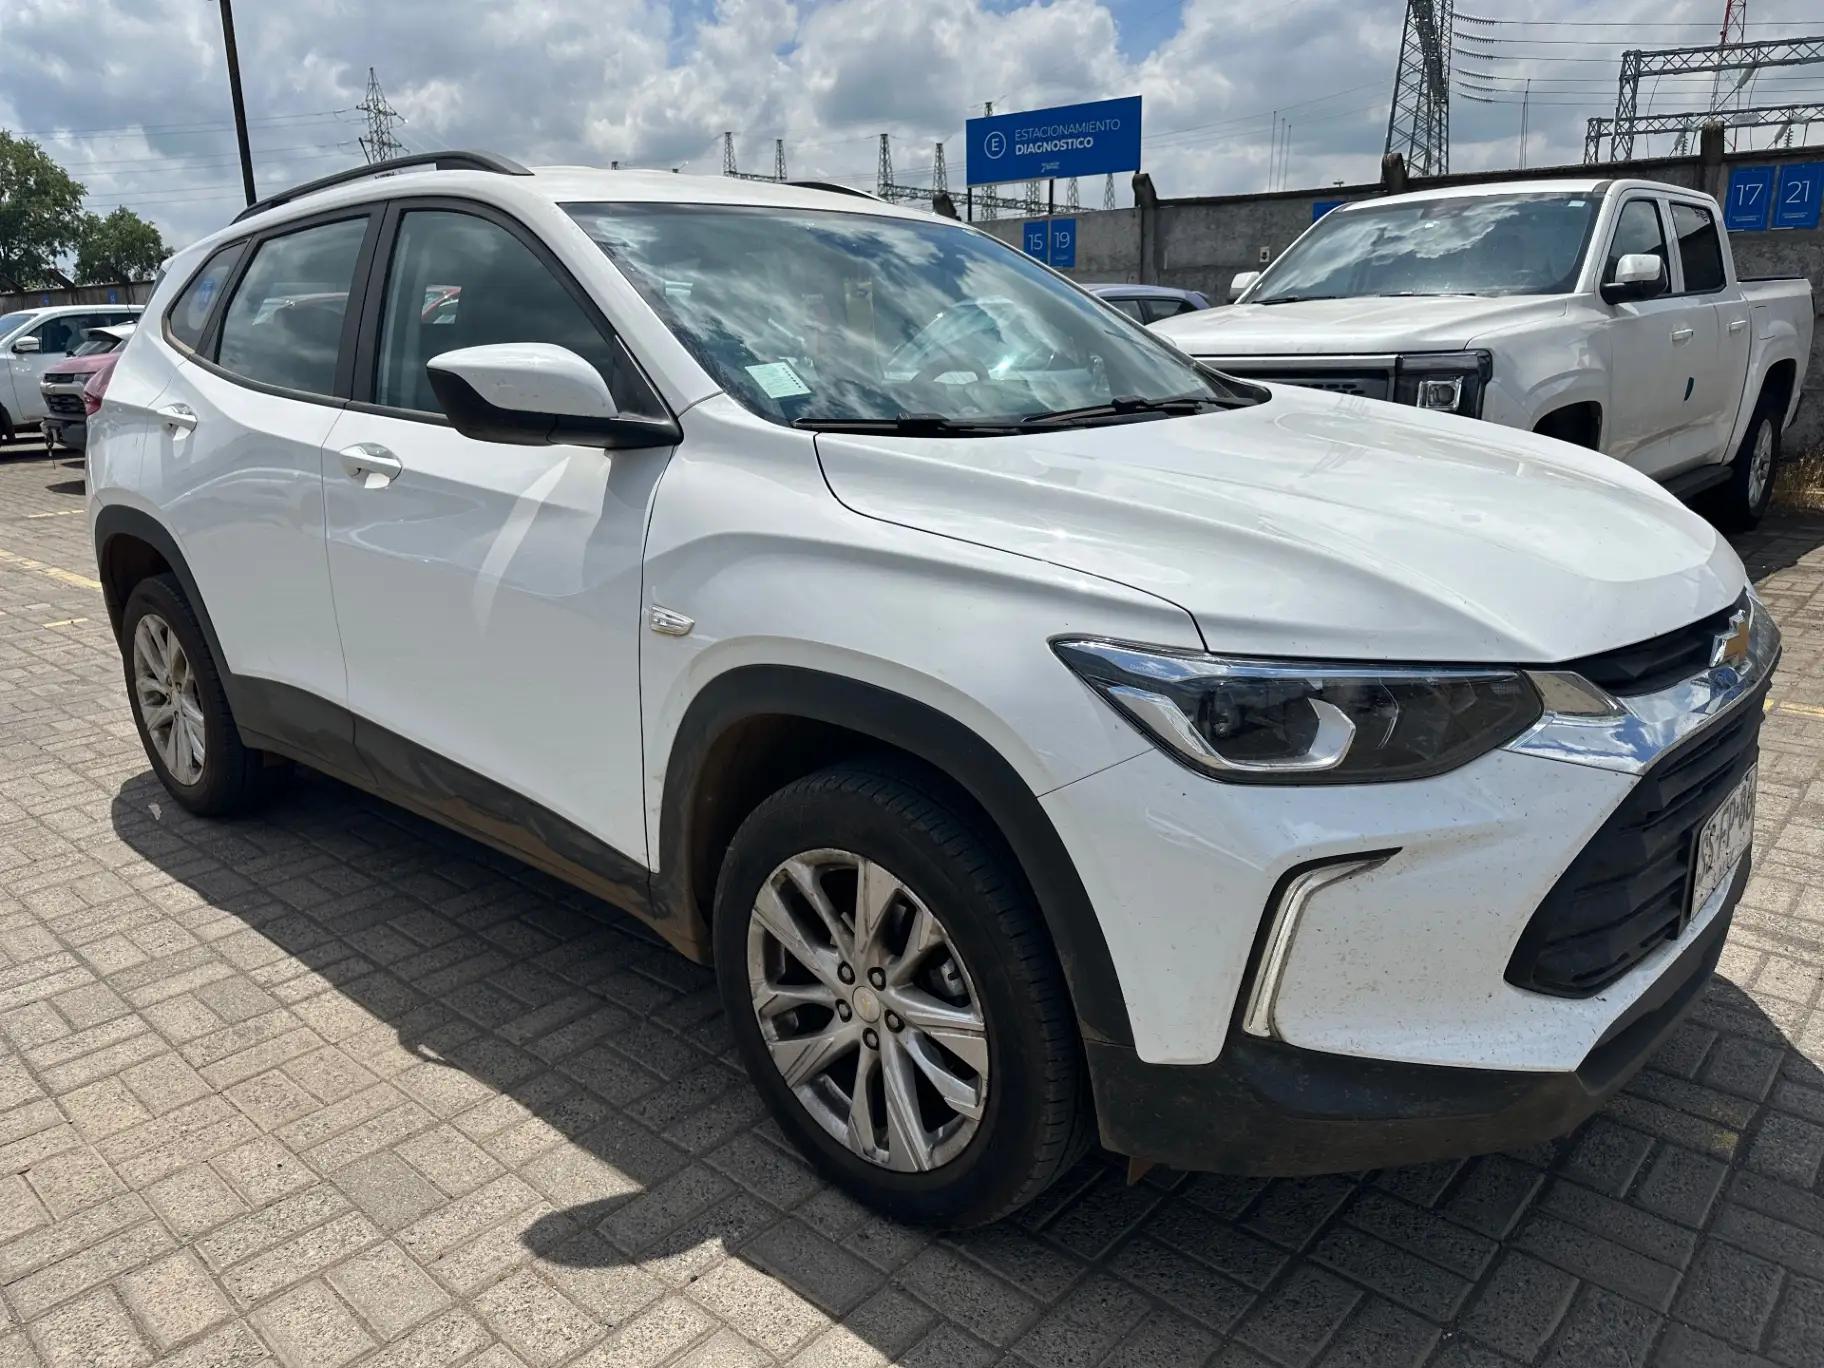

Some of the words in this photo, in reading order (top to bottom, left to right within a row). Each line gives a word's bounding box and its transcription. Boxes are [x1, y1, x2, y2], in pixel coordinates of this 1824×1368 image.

[1015, 119, 1121, 141] ESTACIONAMIENTO
[1015, 137, 1094, 156] DIAGNOSTICO
[1736, 183, 1763, 206] 17
[1785, 180, 1810, 203] 21
[1028, 233, 1043, 250] 15
[1054, 231, 1070, 248] 19
